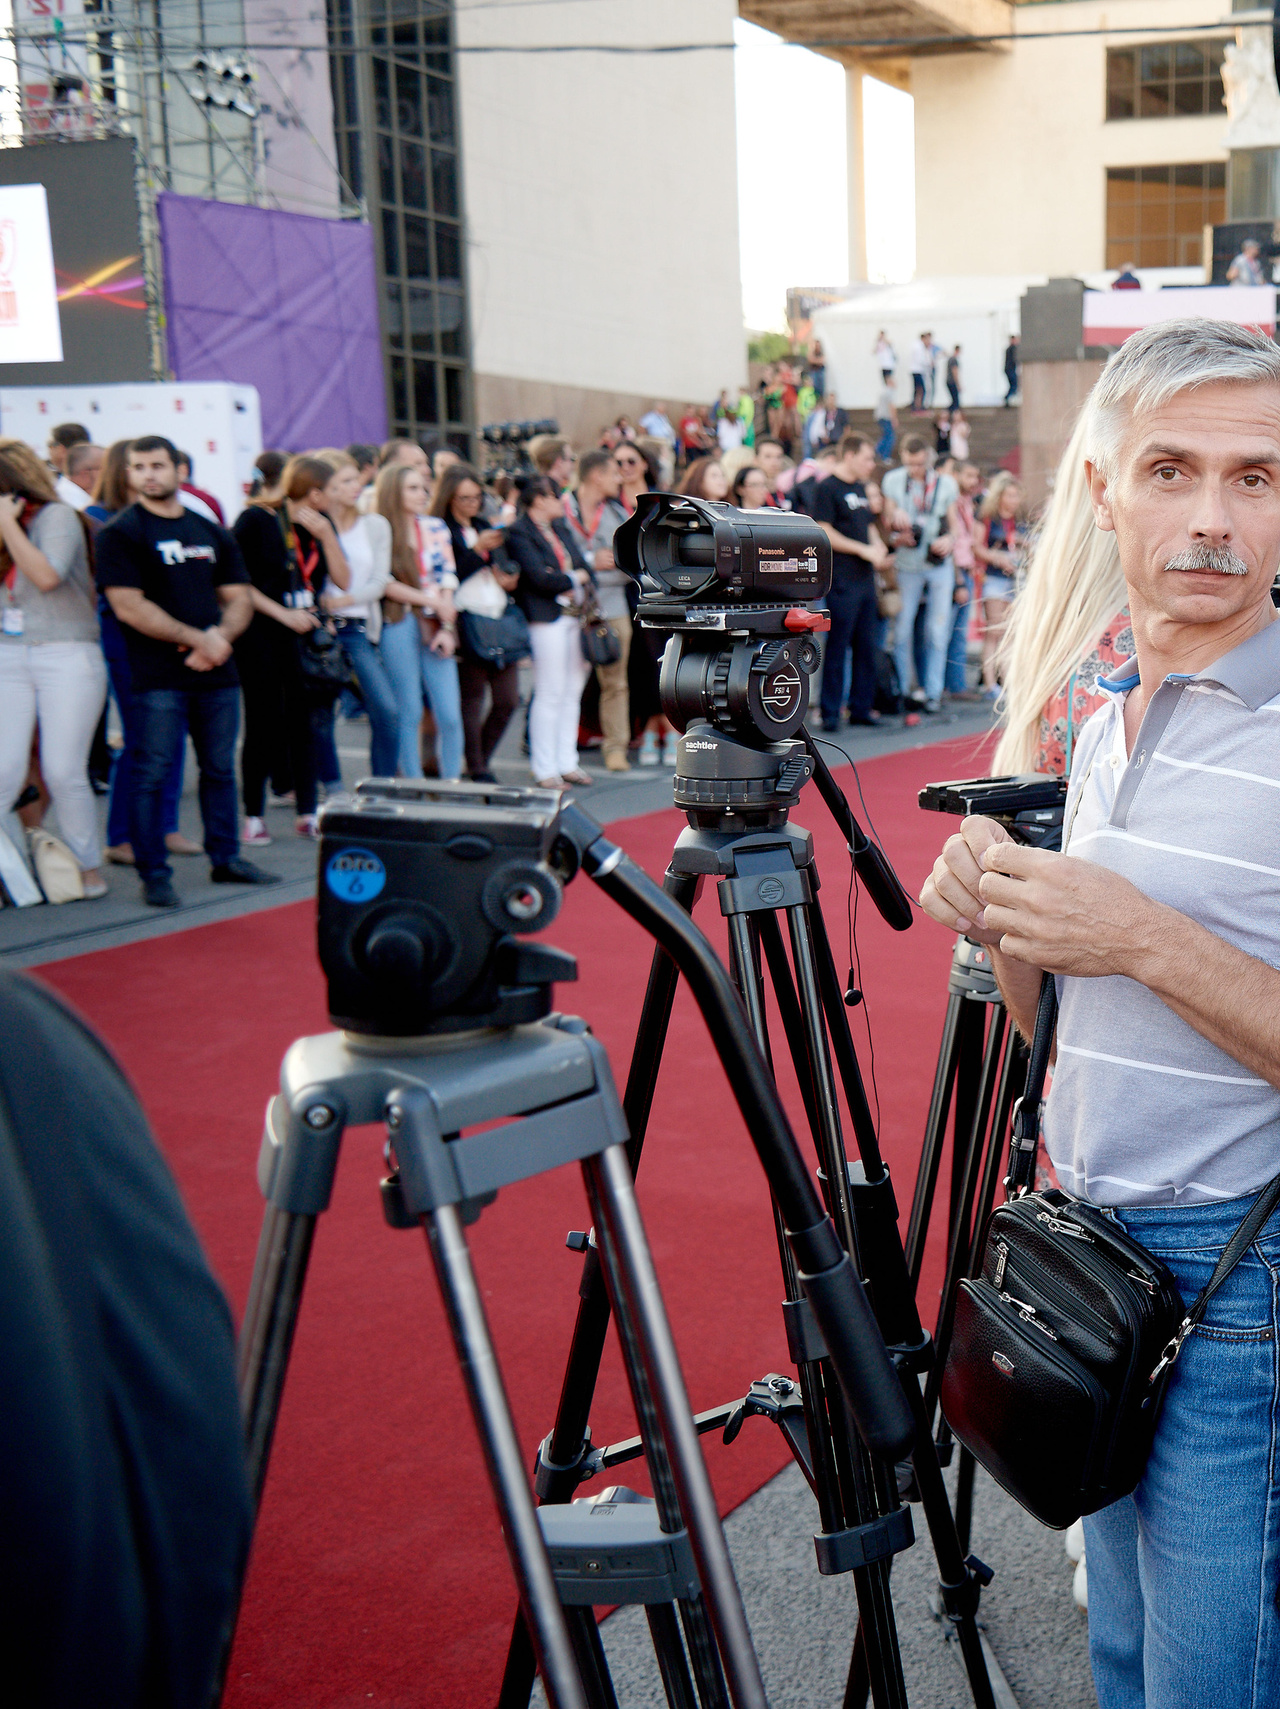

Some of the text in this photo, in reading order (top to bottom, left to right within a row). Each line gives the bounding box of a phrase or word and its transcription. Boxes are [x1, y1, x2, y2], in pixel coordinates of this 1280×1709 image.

[758, 547, 786, 555] Panasonic
[802, 546, 818, 557] 4K
[685, 740, 718, 750] sachtler
